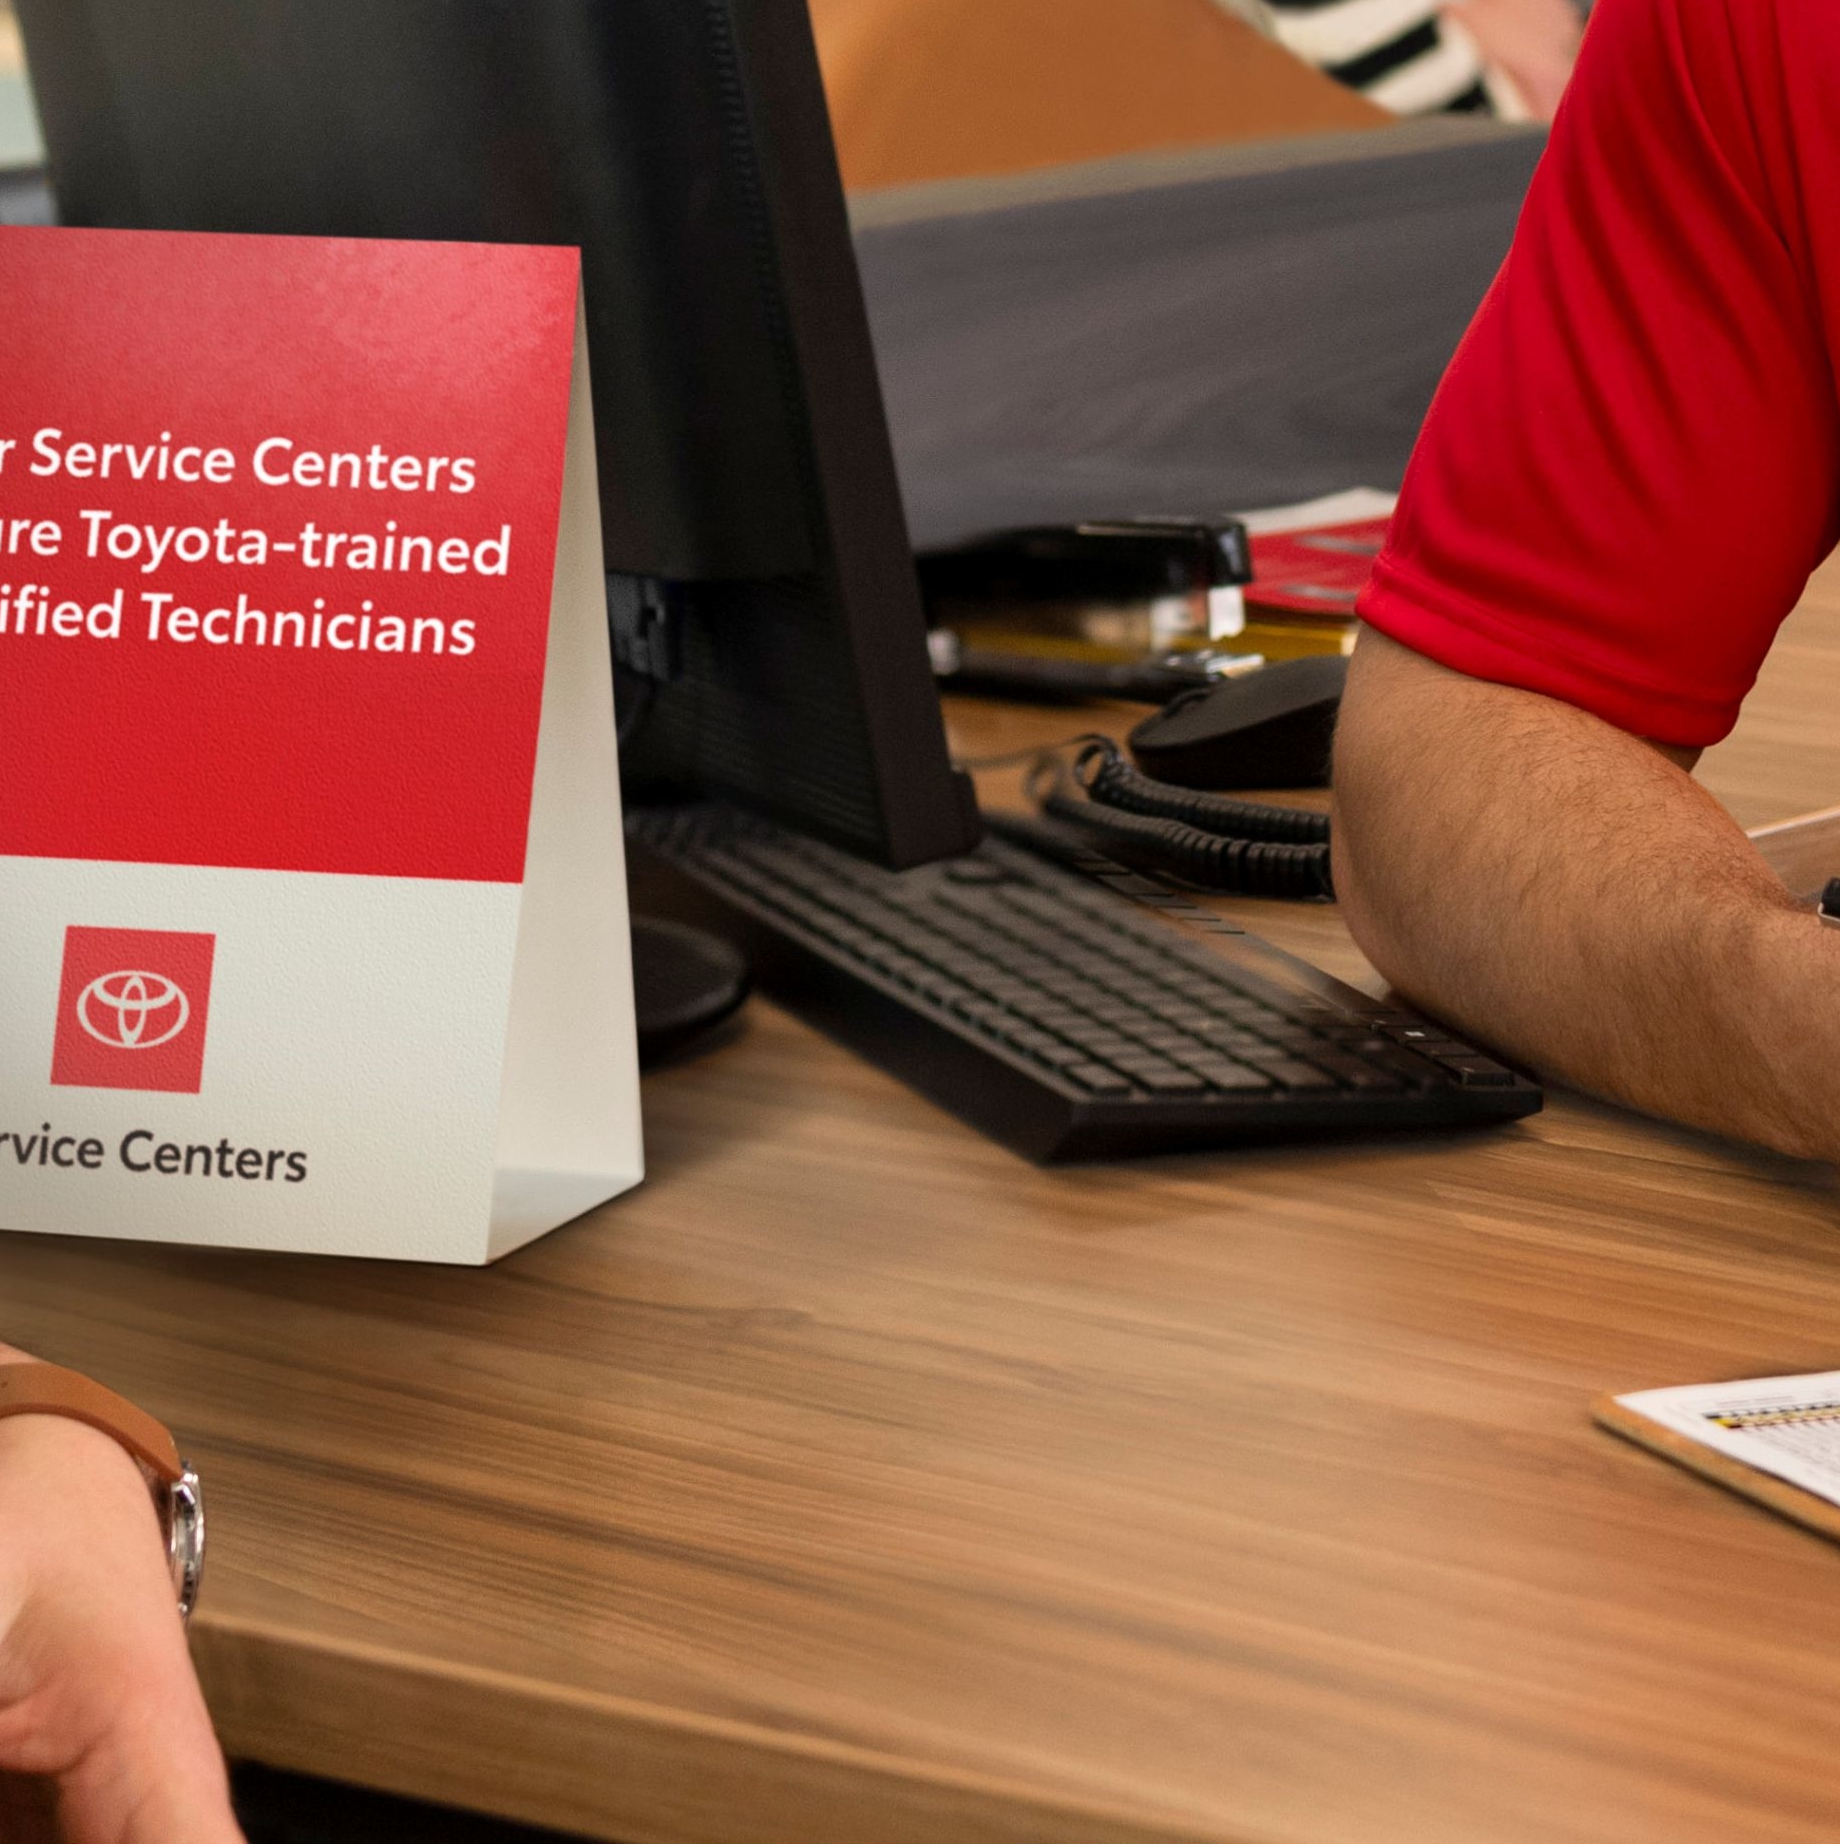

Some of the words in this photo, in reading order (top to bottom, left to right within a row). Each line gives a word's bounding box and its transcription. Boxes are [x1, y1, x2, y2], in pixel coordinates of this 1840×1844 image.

[29, 427, 236, 484] Service
[252, 436, 477, 494] Centers
[79, 509, 512, 576] Toyota-trained
[140, 591, 476, 655] Technicians
[118, 1128, 308, 1184] Centers
